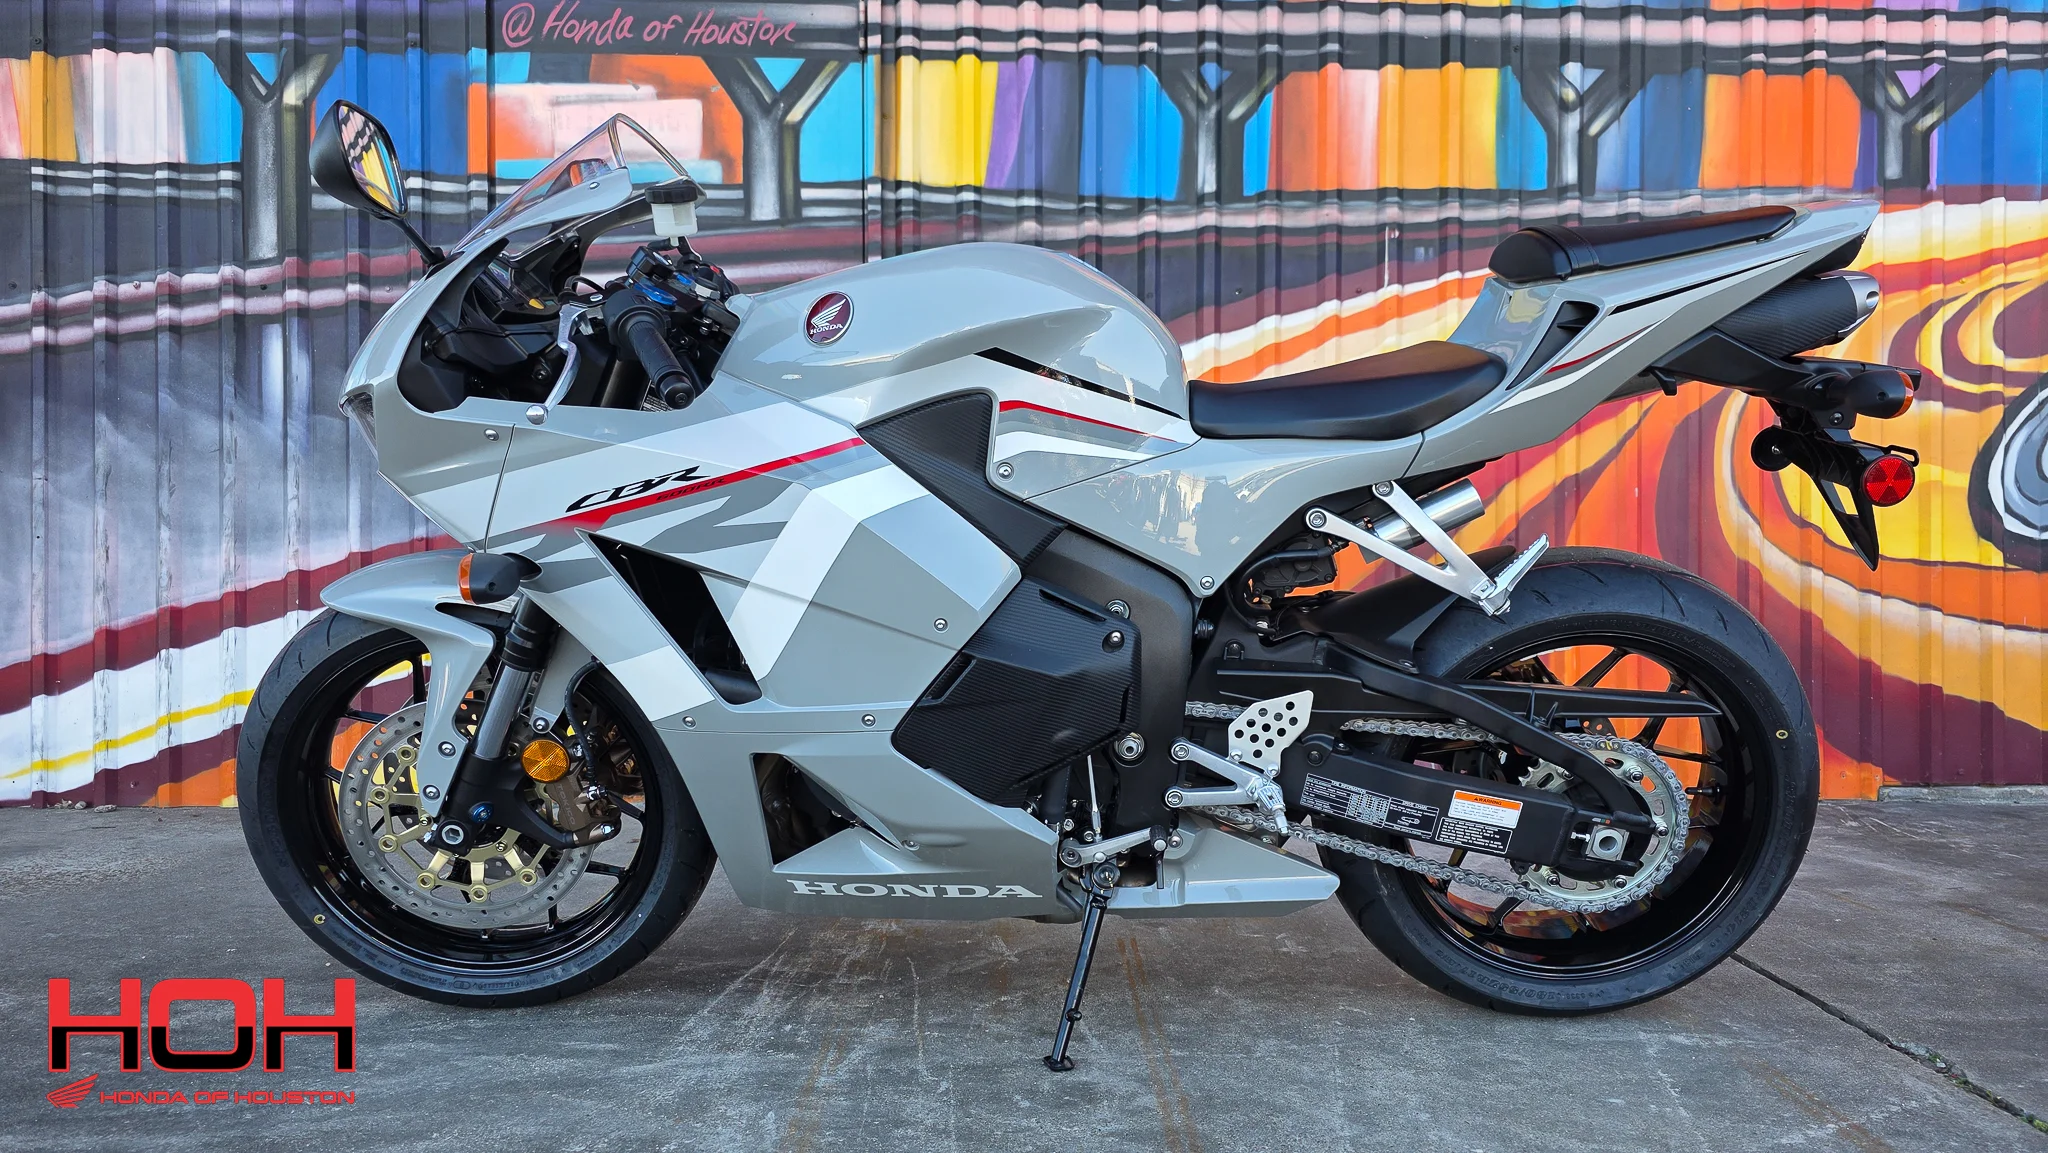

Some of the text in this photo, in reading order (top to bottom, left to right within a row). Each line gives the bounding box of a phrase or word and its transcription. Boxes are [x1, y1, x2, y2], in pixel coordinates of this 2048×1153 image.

[502, 0, 797, 48] @ Honda of Houston
[810, 323, 844, 335] HONDA
[565, 465, 711, 513] CBR
[656, 478, 725, 501] 600RR
[557, 784, 576, 826] TOKICO
[1478, 796, 1503, 806] WARNING
[786, 879, 1043, 899] HONDA
